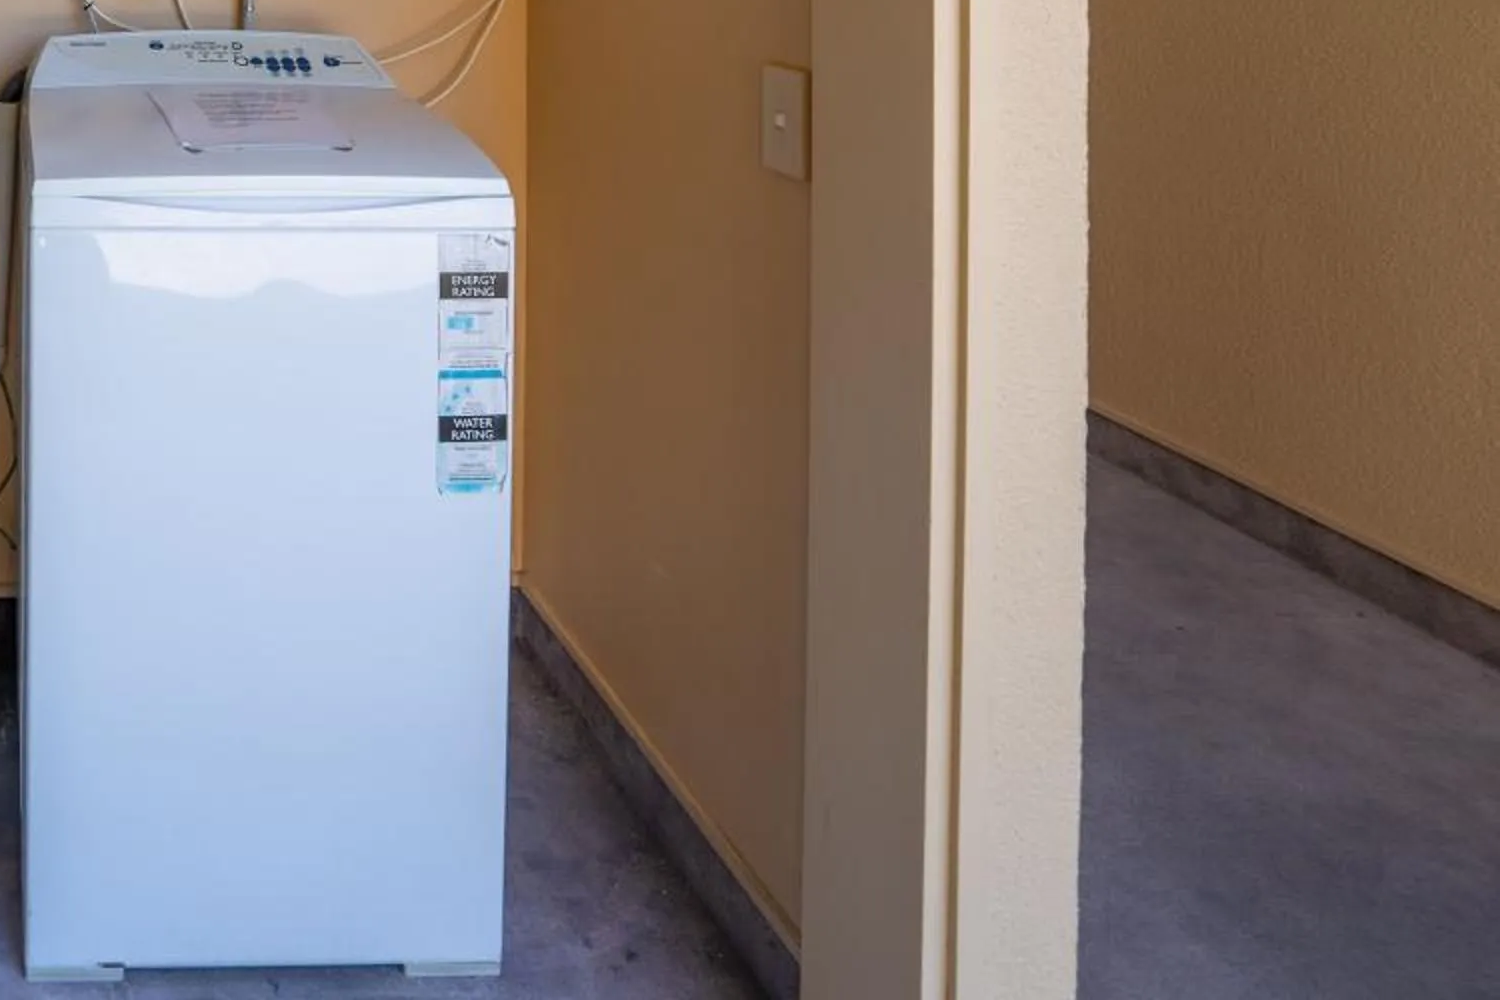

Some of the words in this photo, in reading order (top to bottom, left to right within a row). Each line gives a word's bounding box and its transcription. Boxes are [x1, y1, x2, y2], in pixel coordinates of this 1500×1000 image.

[451, 275, 497, 286] ENERGY
[451, 287, 495, 297] RATING
[453, 417, 493, 429] WATER
[451, 429, 495, 441] RATING
